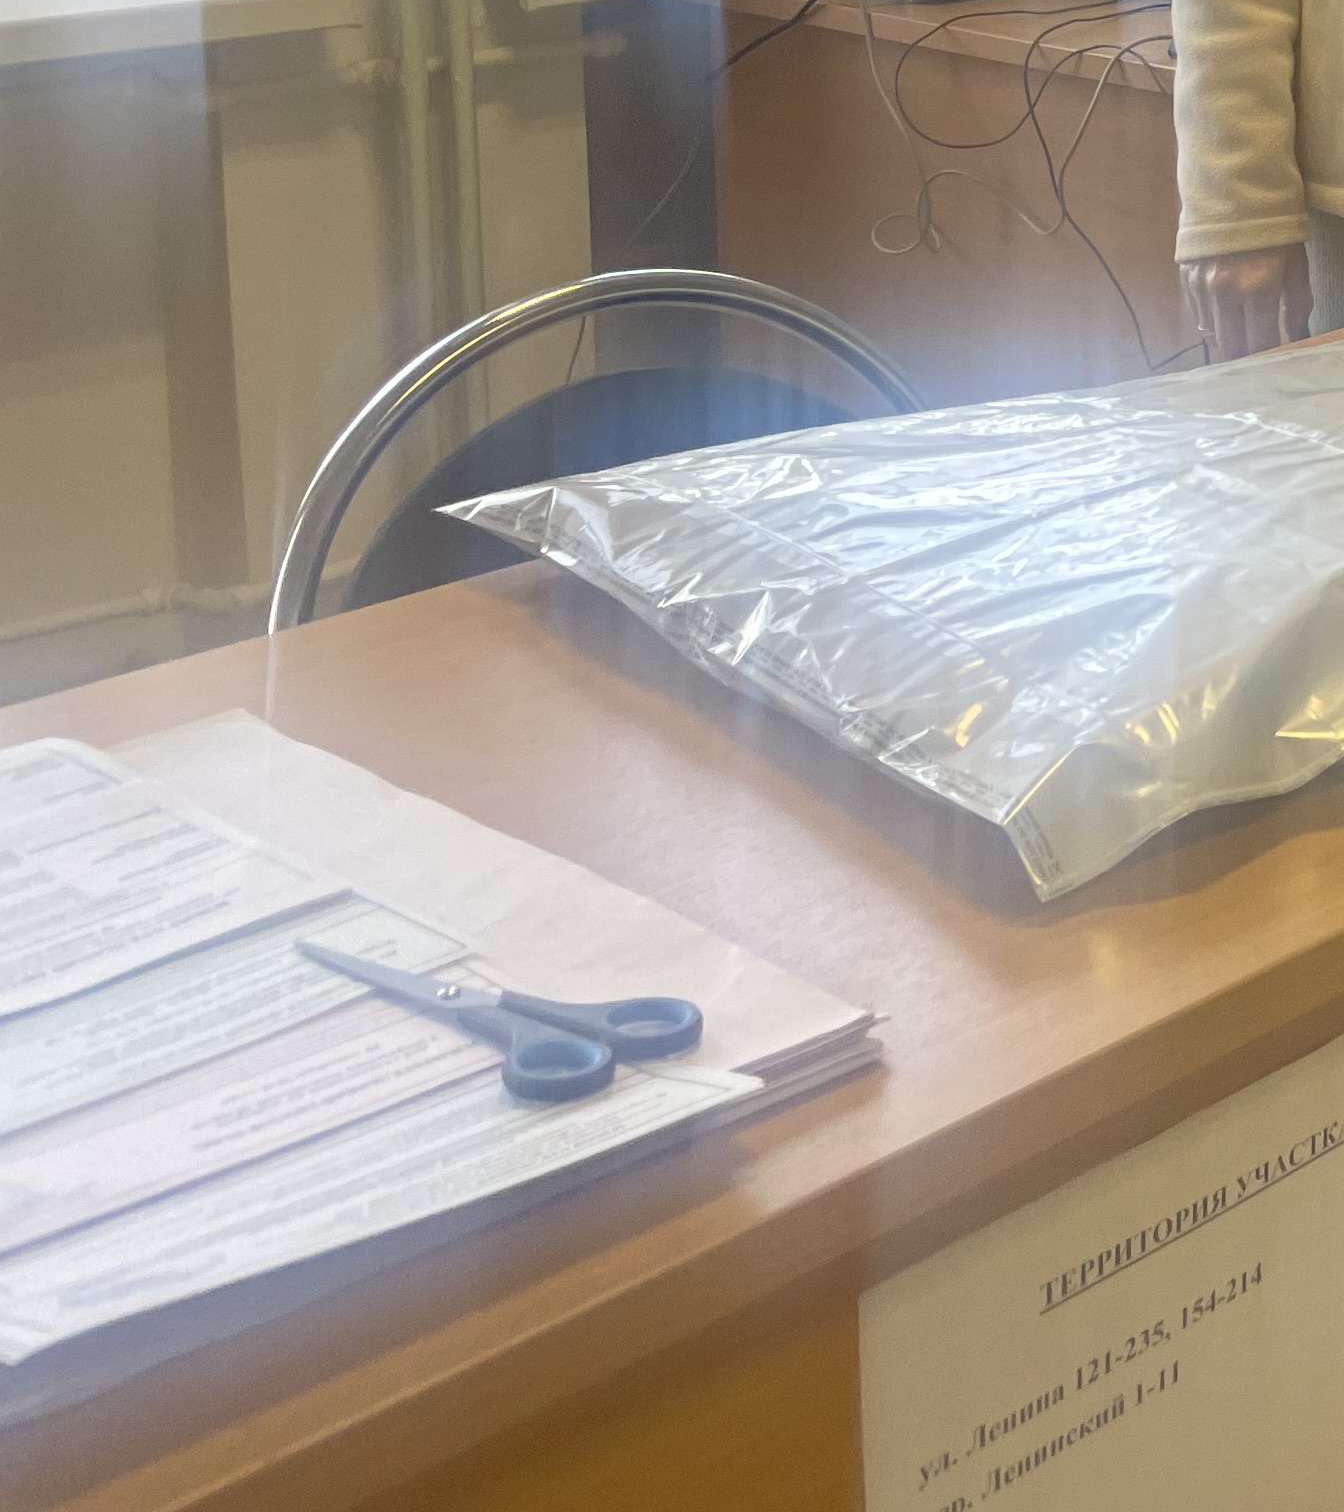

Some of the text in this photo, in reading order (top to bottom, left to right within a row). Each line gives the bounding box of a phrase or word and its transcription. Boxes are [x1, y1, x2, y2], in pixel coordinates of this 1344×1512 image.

[1039, 1186, 1229, 1311] ТЕРРИТОРИЯ
[918, 1261, 1265, 1492] ул. Ленина 121-235, 154-214
[980, 1393, 1126, 1502] Ленинский
[1134, 1360, 1181, 1409] 1-11
